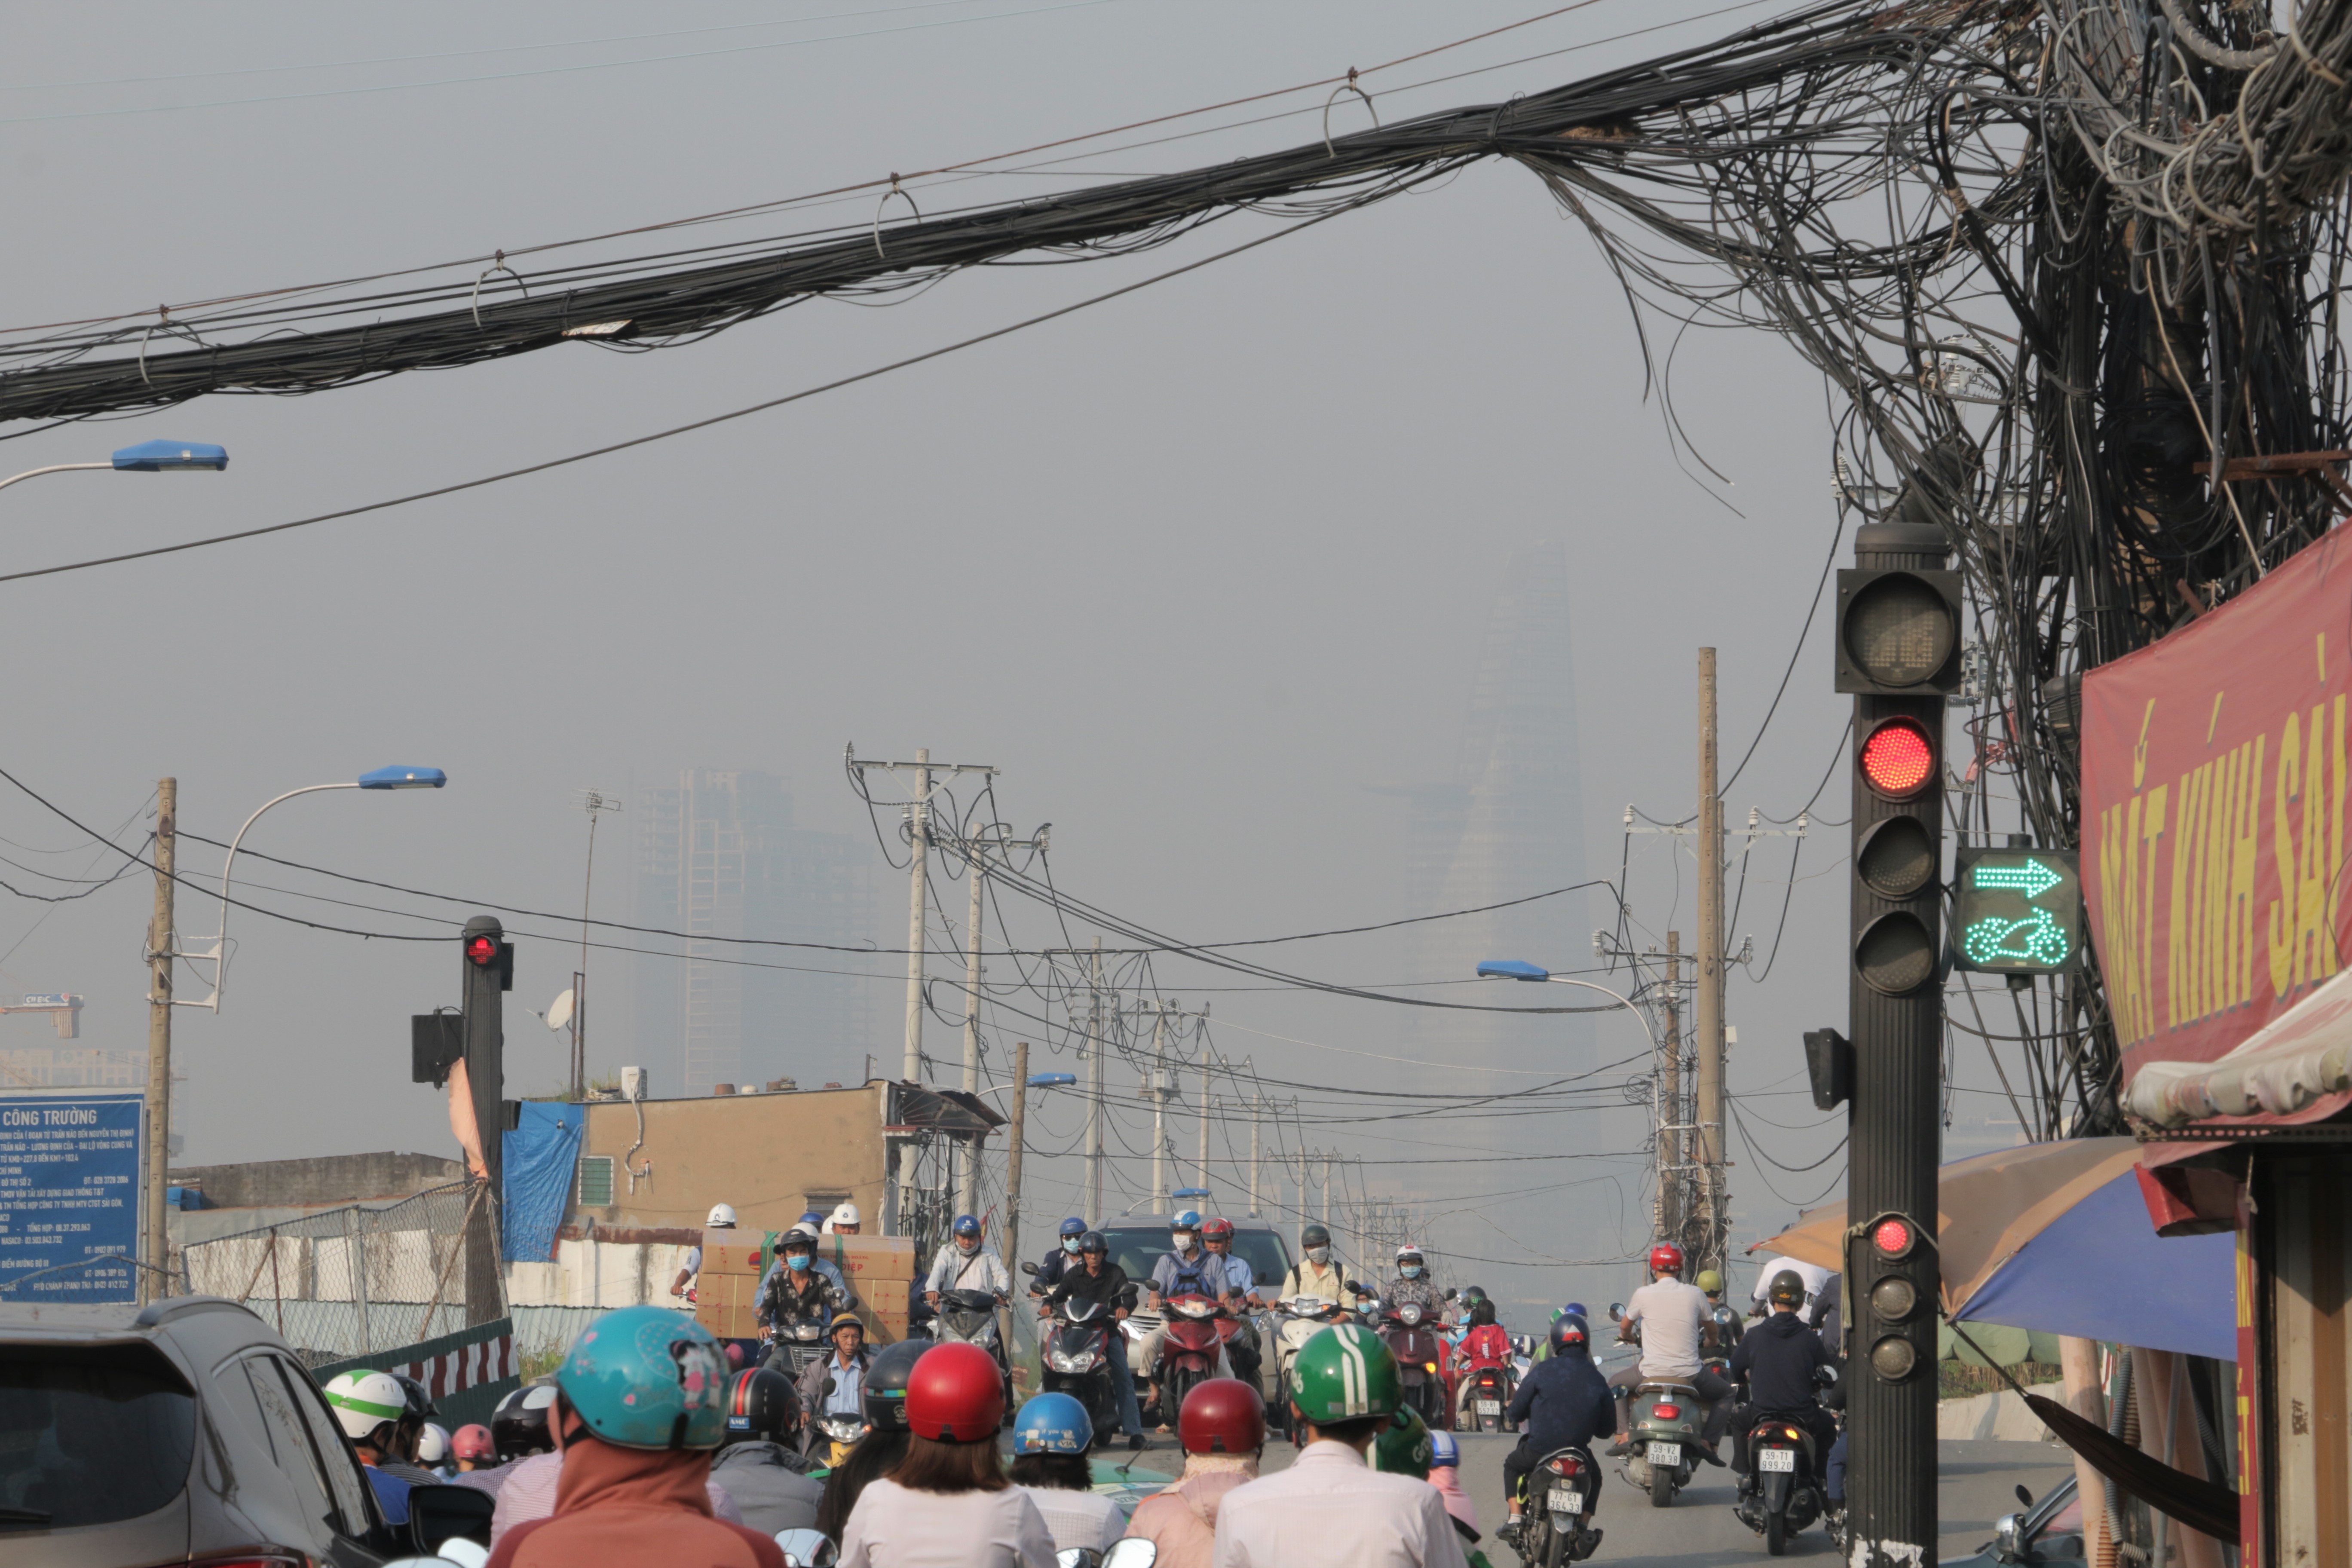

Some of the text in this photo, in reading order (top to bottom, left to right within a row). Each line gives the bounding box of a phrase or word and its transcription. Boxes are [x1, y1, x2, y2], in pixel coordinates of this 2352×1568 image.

[2168, 691, 2266, 1033] KÍNH
[3, 1106, 97, 1126] CÔNG TRƯỜNG
[1654, 1444, 1676, 1455] 59-V2
[1650, 1453, 1678, 1464] 380.38
[1766, 1451, 1788, 1461] 59-T1
[1762, 1460, 1791, 1470] 999.20
[1554, 1491, 1577, 1502] 77-G1
[1550, 1500, 1580, 1512] 364.33
